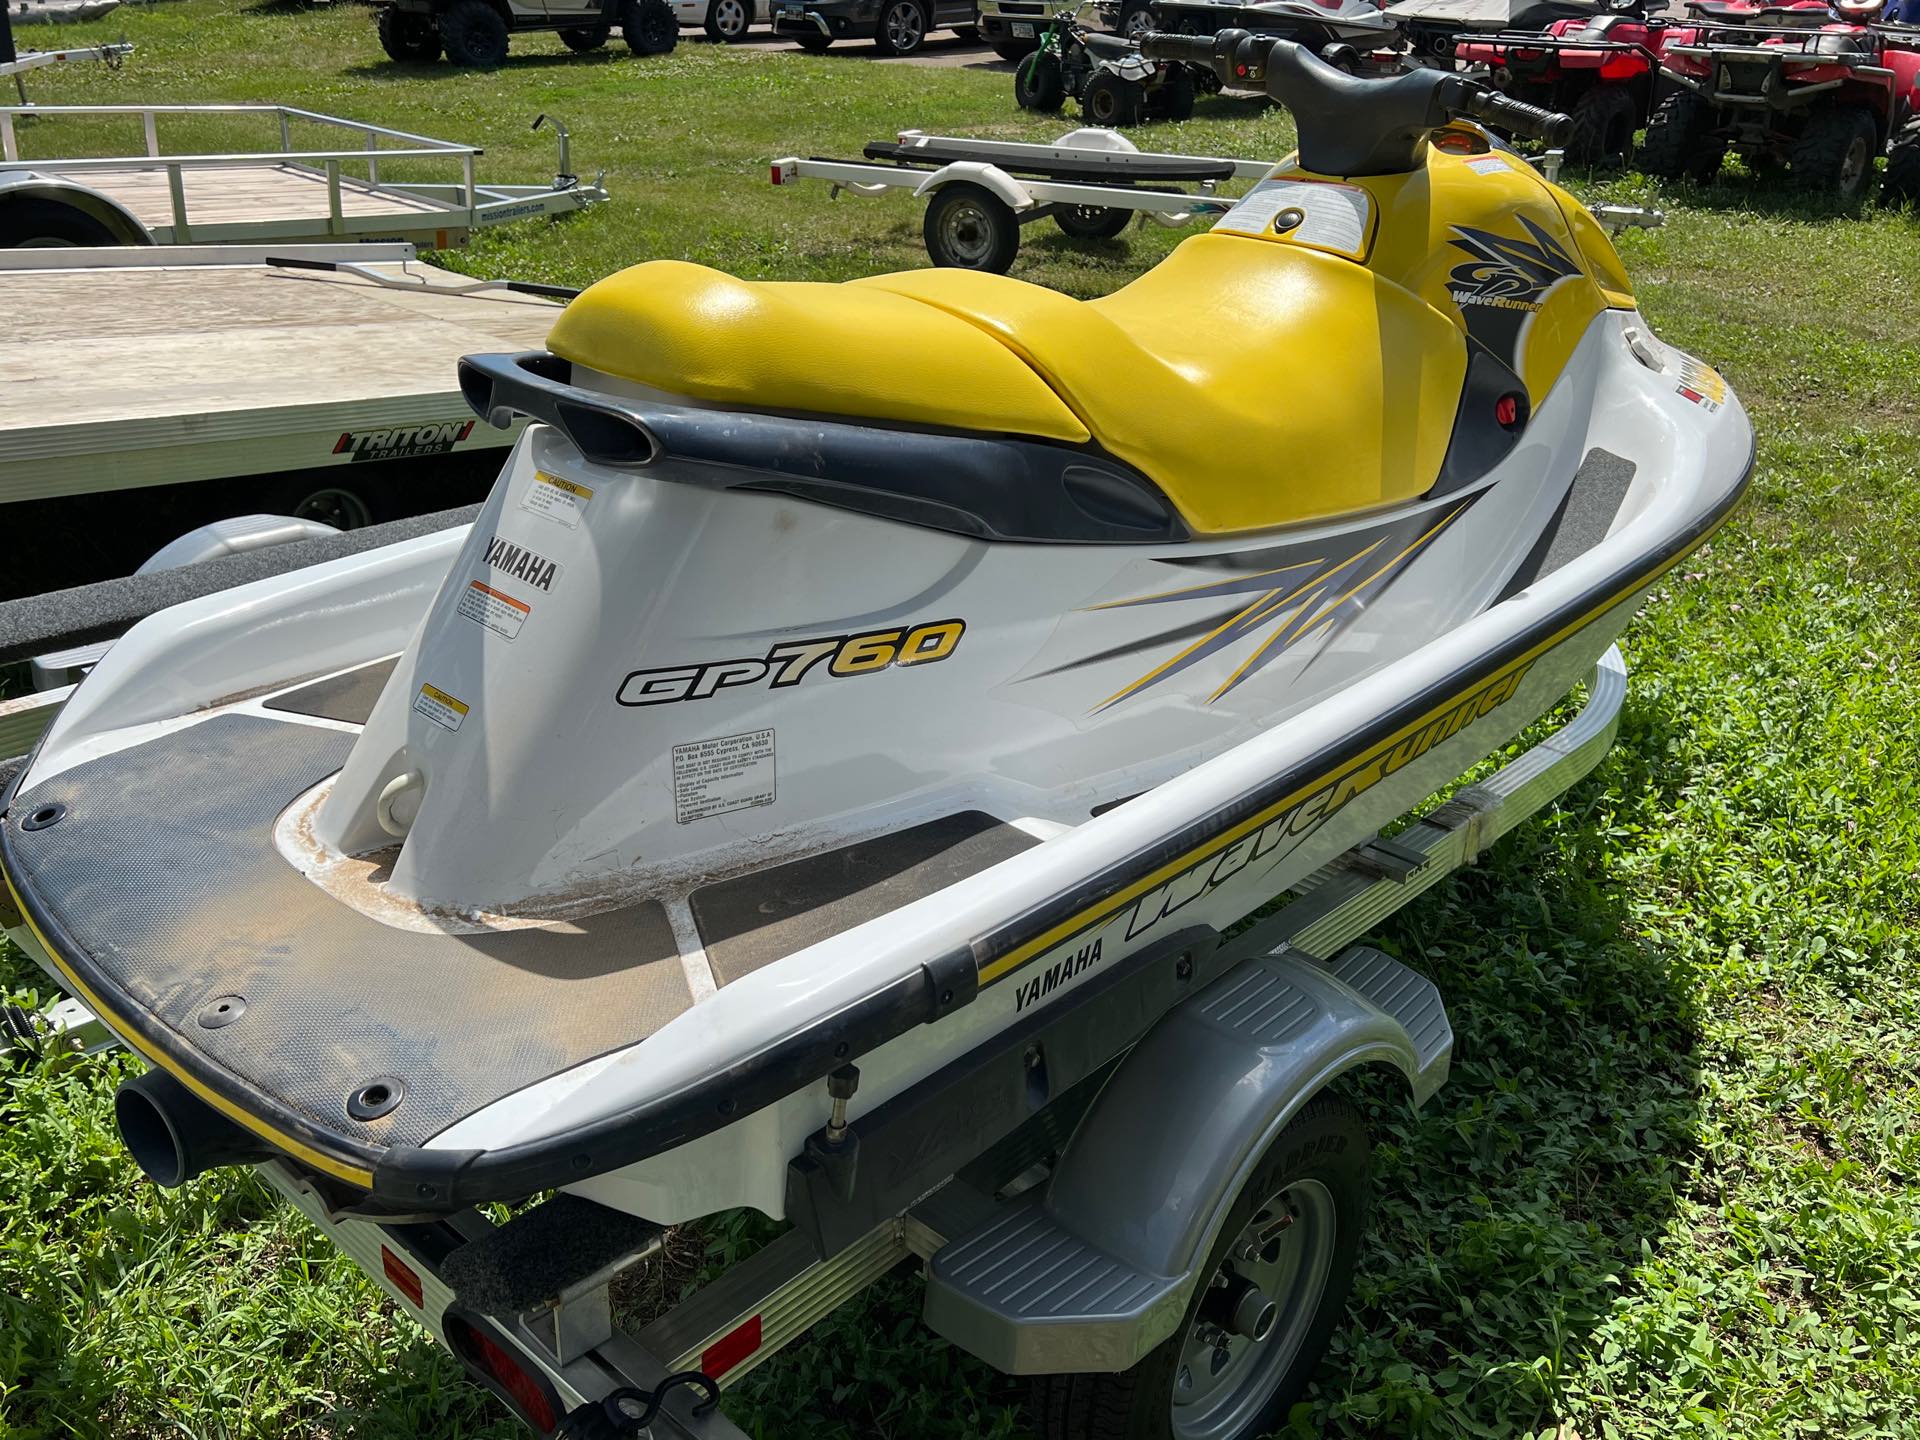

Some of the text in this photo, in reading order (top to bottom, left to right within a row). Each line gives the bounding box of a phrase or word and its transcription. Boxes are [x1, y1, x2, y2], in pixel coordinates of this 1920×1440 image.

[481, 203, 545, 222] missiontrailers.com
[1451, 290, 1543, 312] WaveRunner
[350, 422, 464, 452] TRITON
[370, 443, 442, 459] TRAILERS
[548, 476, 577, 494] CAUTION
[483, 536, 557, 591] YAMAHA
[616, 618, 966, 707] GP760
[675, 745, 699, 755] YAMAHA
[702, 741, 718, 750] Motor
[1124, 660, 1537, 940] WaveRunner
[1015, 937, 1103, 1012] YAMAHA
